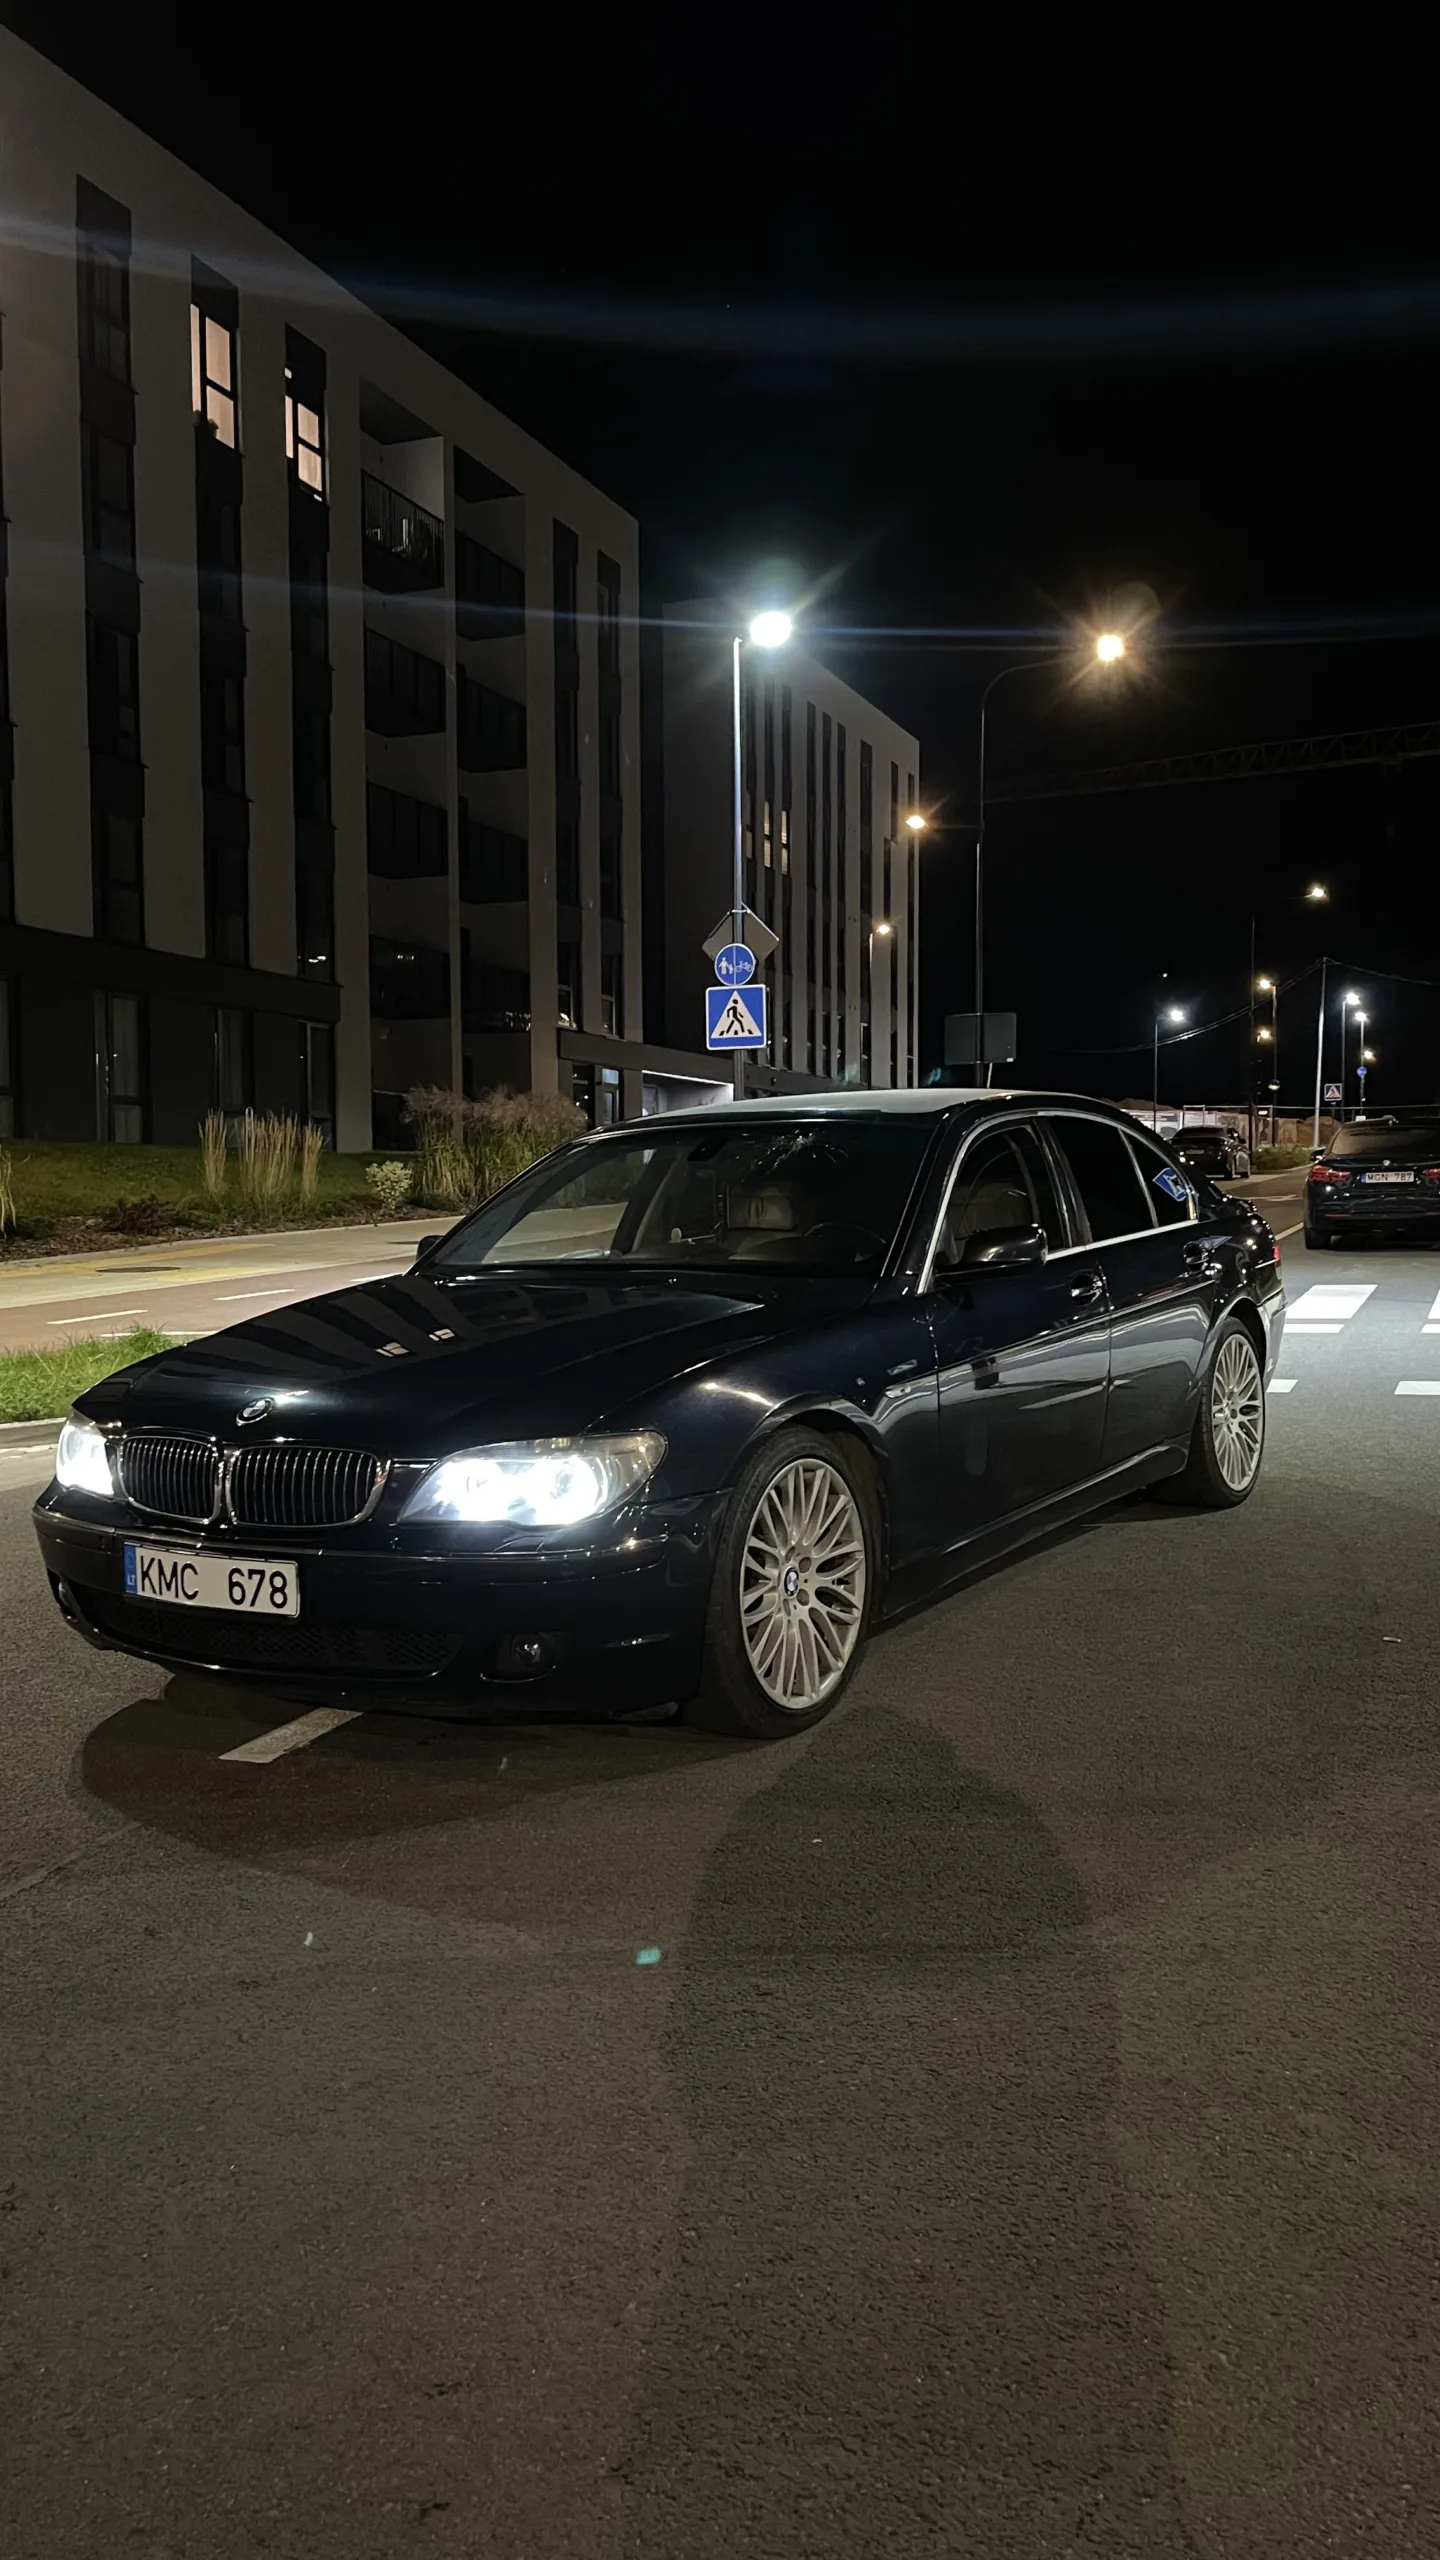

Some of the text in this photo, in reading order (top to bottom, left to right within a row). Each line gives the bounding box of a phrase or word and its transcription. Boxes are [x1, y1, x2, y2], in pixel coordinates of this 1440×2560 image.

[1367, 1174, 1388, 1182] MGN
[1394, 1173, 1412, 1181] 787
[127, 1574, 136, 1586] LT
[140, 1556, 288, 1609] KMC 678
